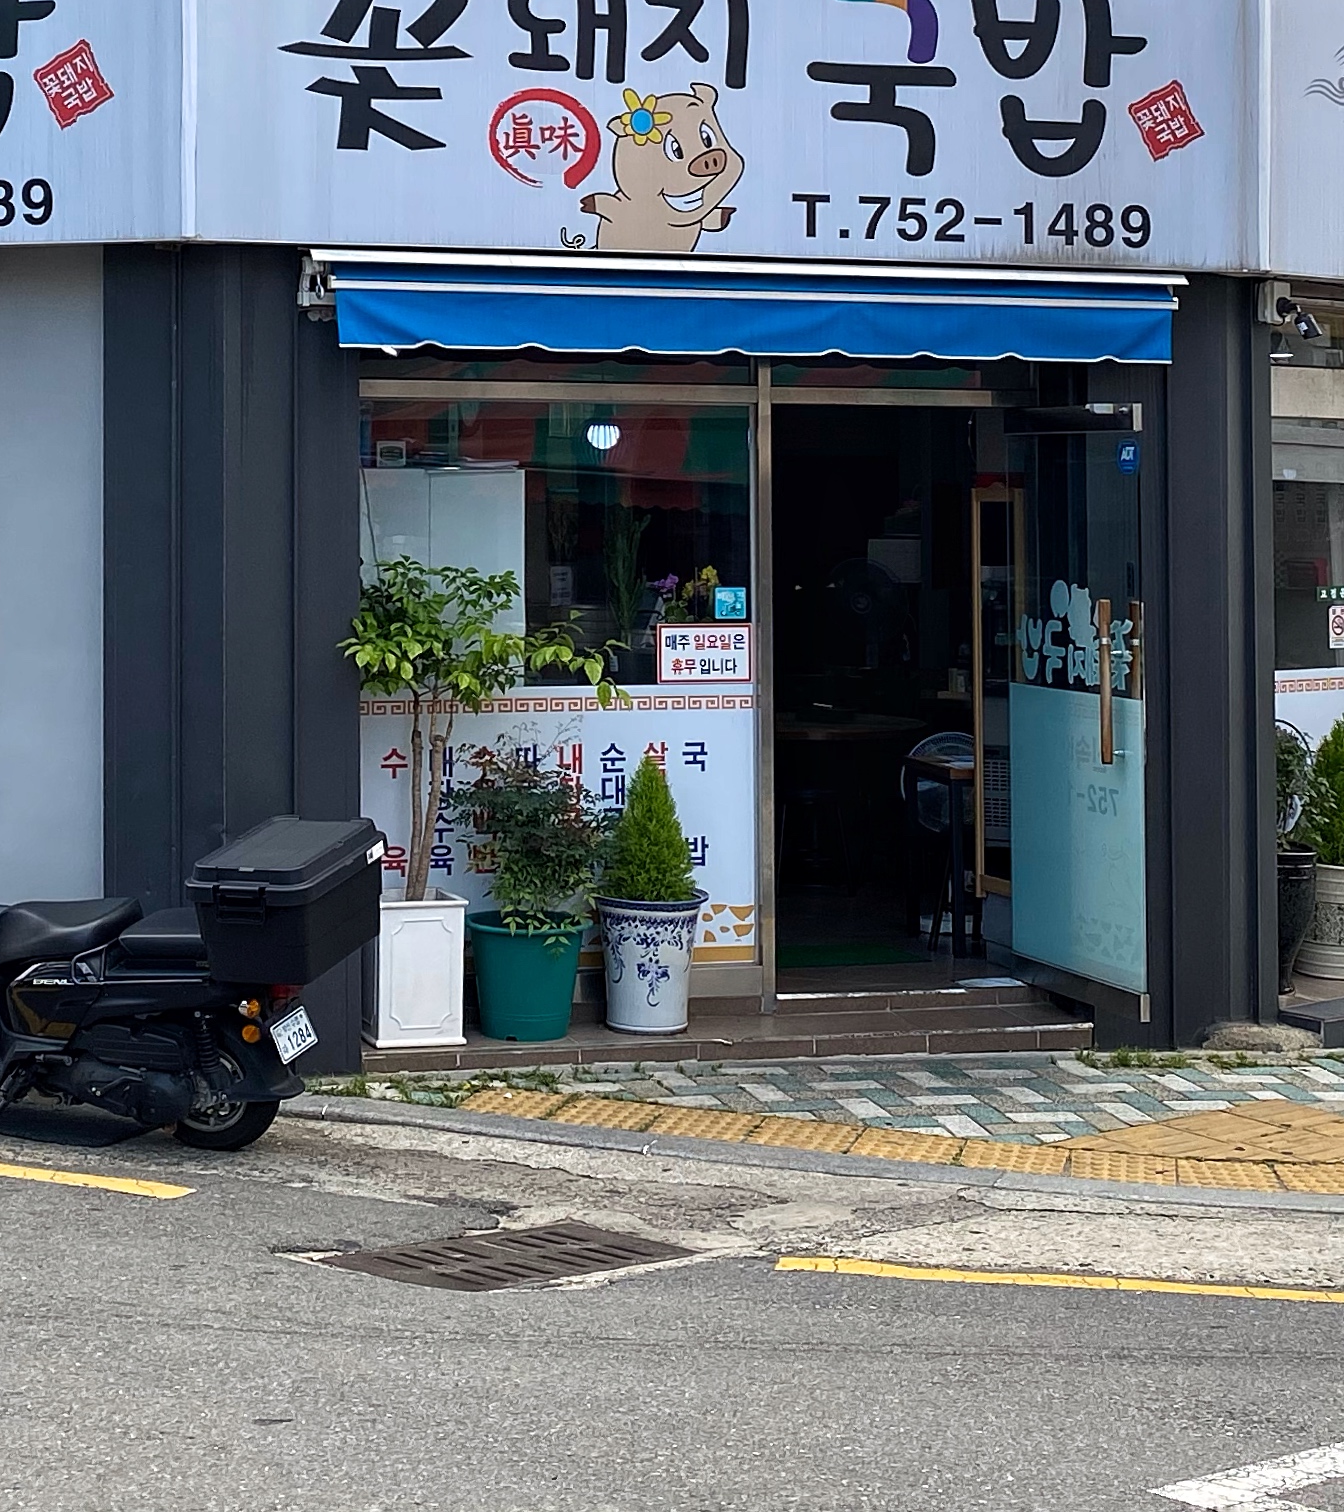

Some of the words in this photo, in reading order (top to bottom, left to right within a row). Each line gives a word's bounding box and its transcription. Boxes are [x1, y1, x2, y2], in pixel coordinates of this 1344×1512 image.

[61, 77, 98, 109] 국밥
[1154, 114, 1189, 143] 국밥
[791, 191, 1154, 250] T.752-1489
[665, 634, 690, 651] 매주
[693, 633, 746, 651] 일요일은
[288, 1023, 312, 1050] 1284
